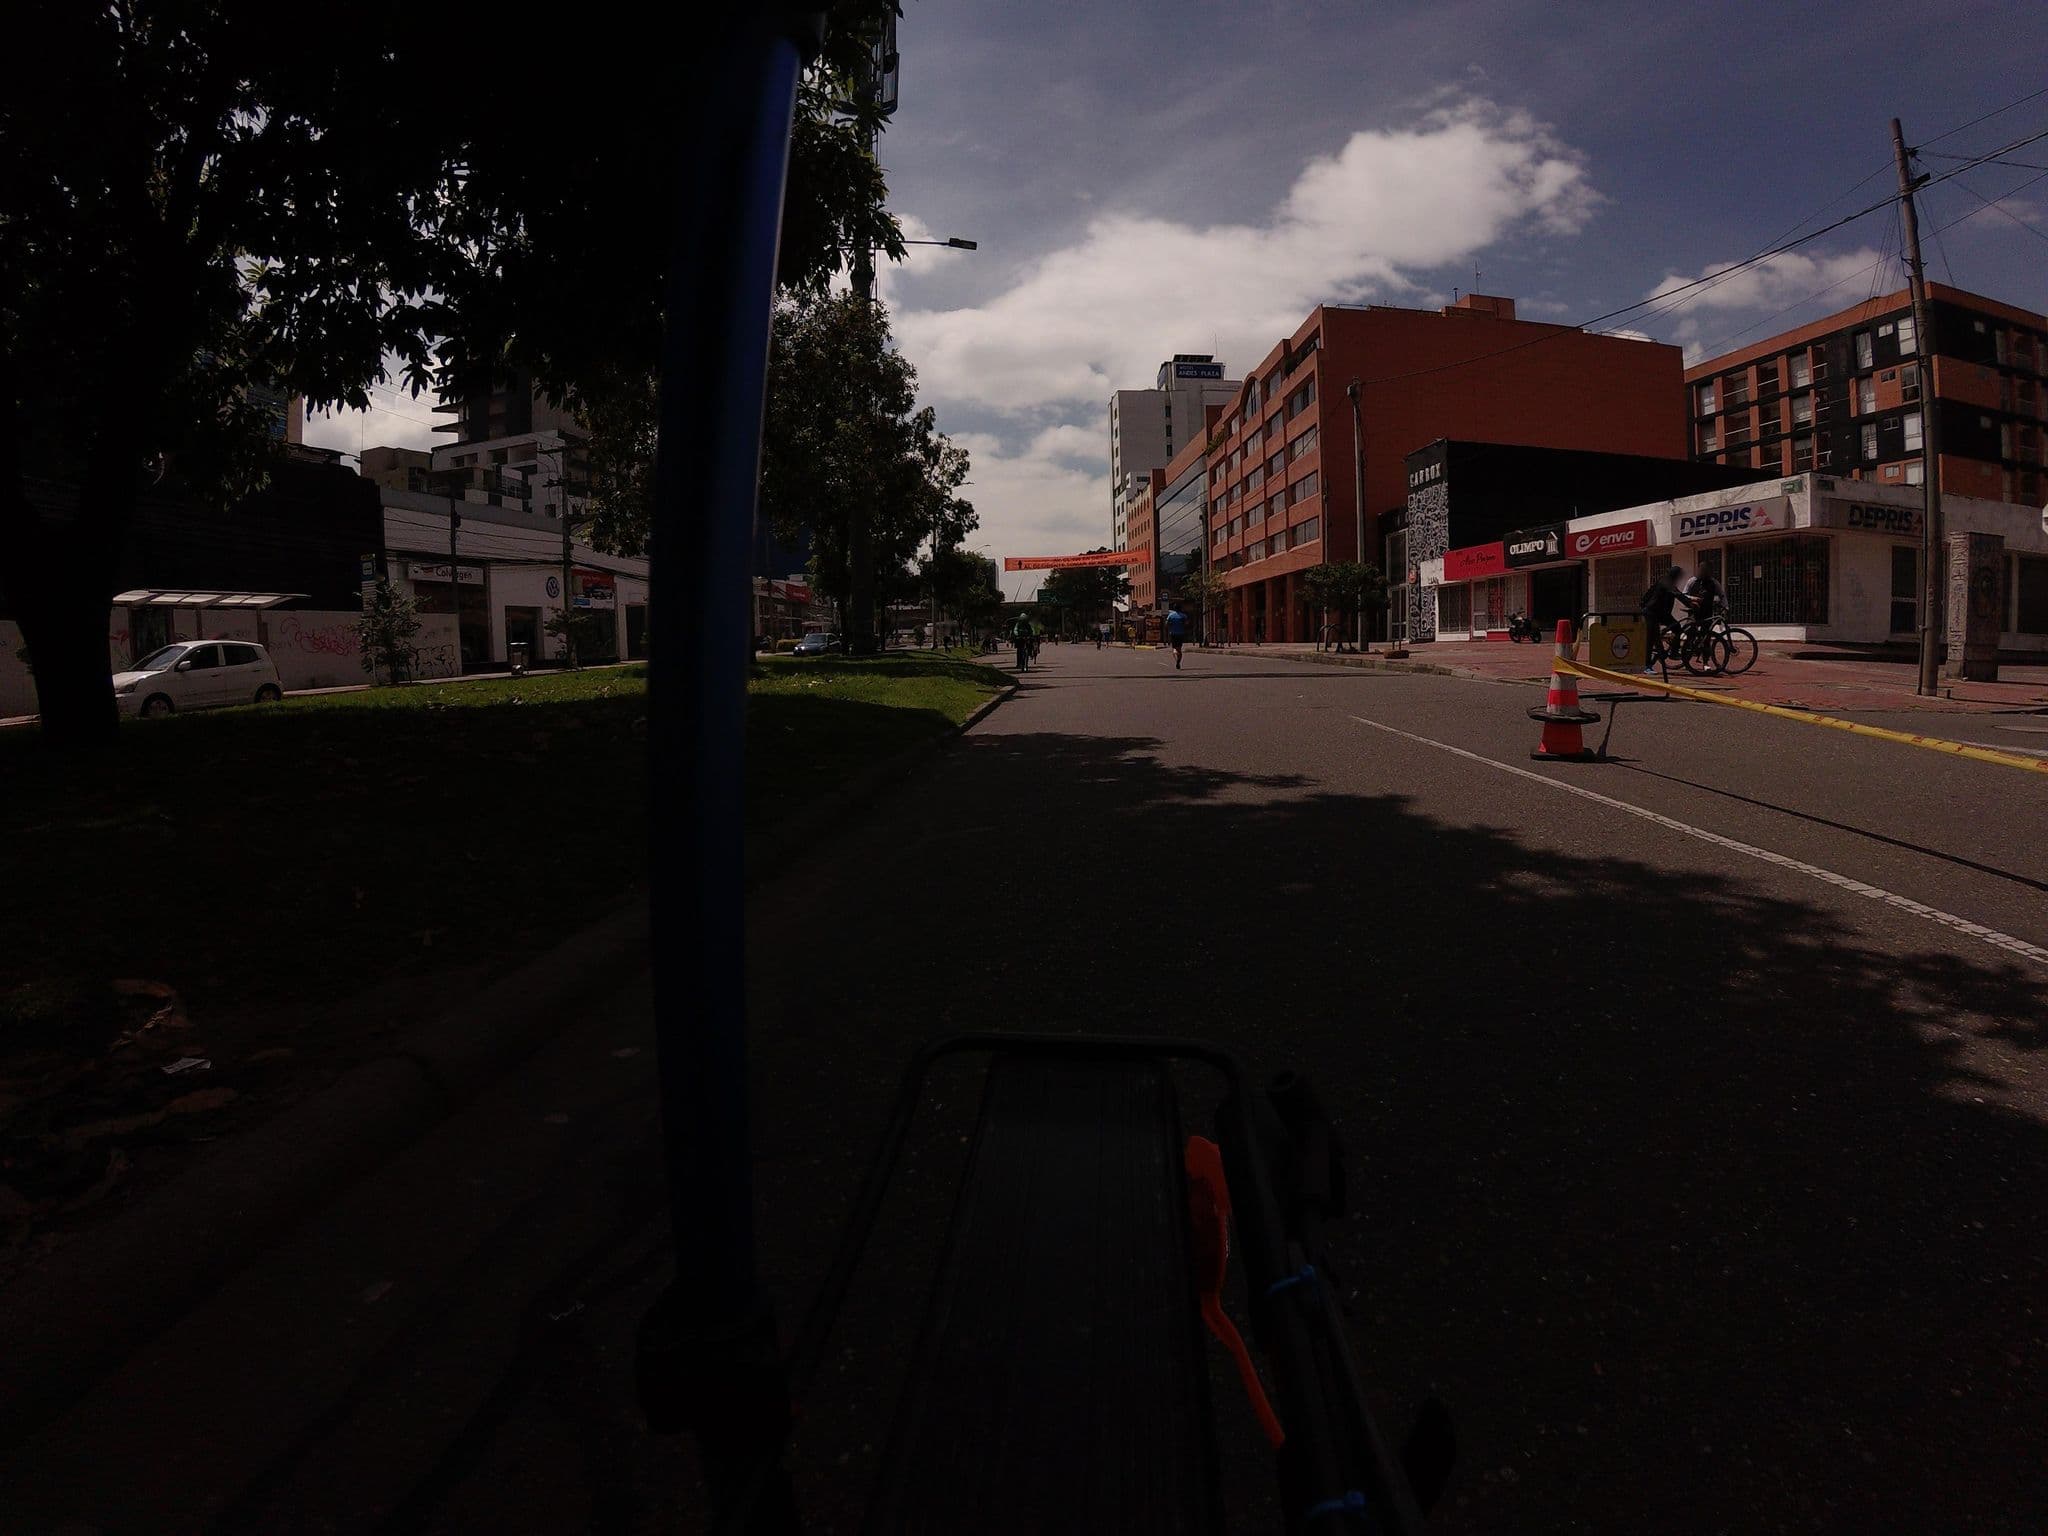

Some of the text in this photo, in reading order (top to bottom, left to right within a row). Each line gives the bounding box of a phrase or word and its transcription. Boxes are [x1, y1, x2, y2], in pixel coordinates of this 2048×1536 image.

[1680, 508, 1751, 537] DEPRIS
[1849, 505, 1912, 530] DEPRIS
[1509, 539, 1545, 555] OLIMPO
